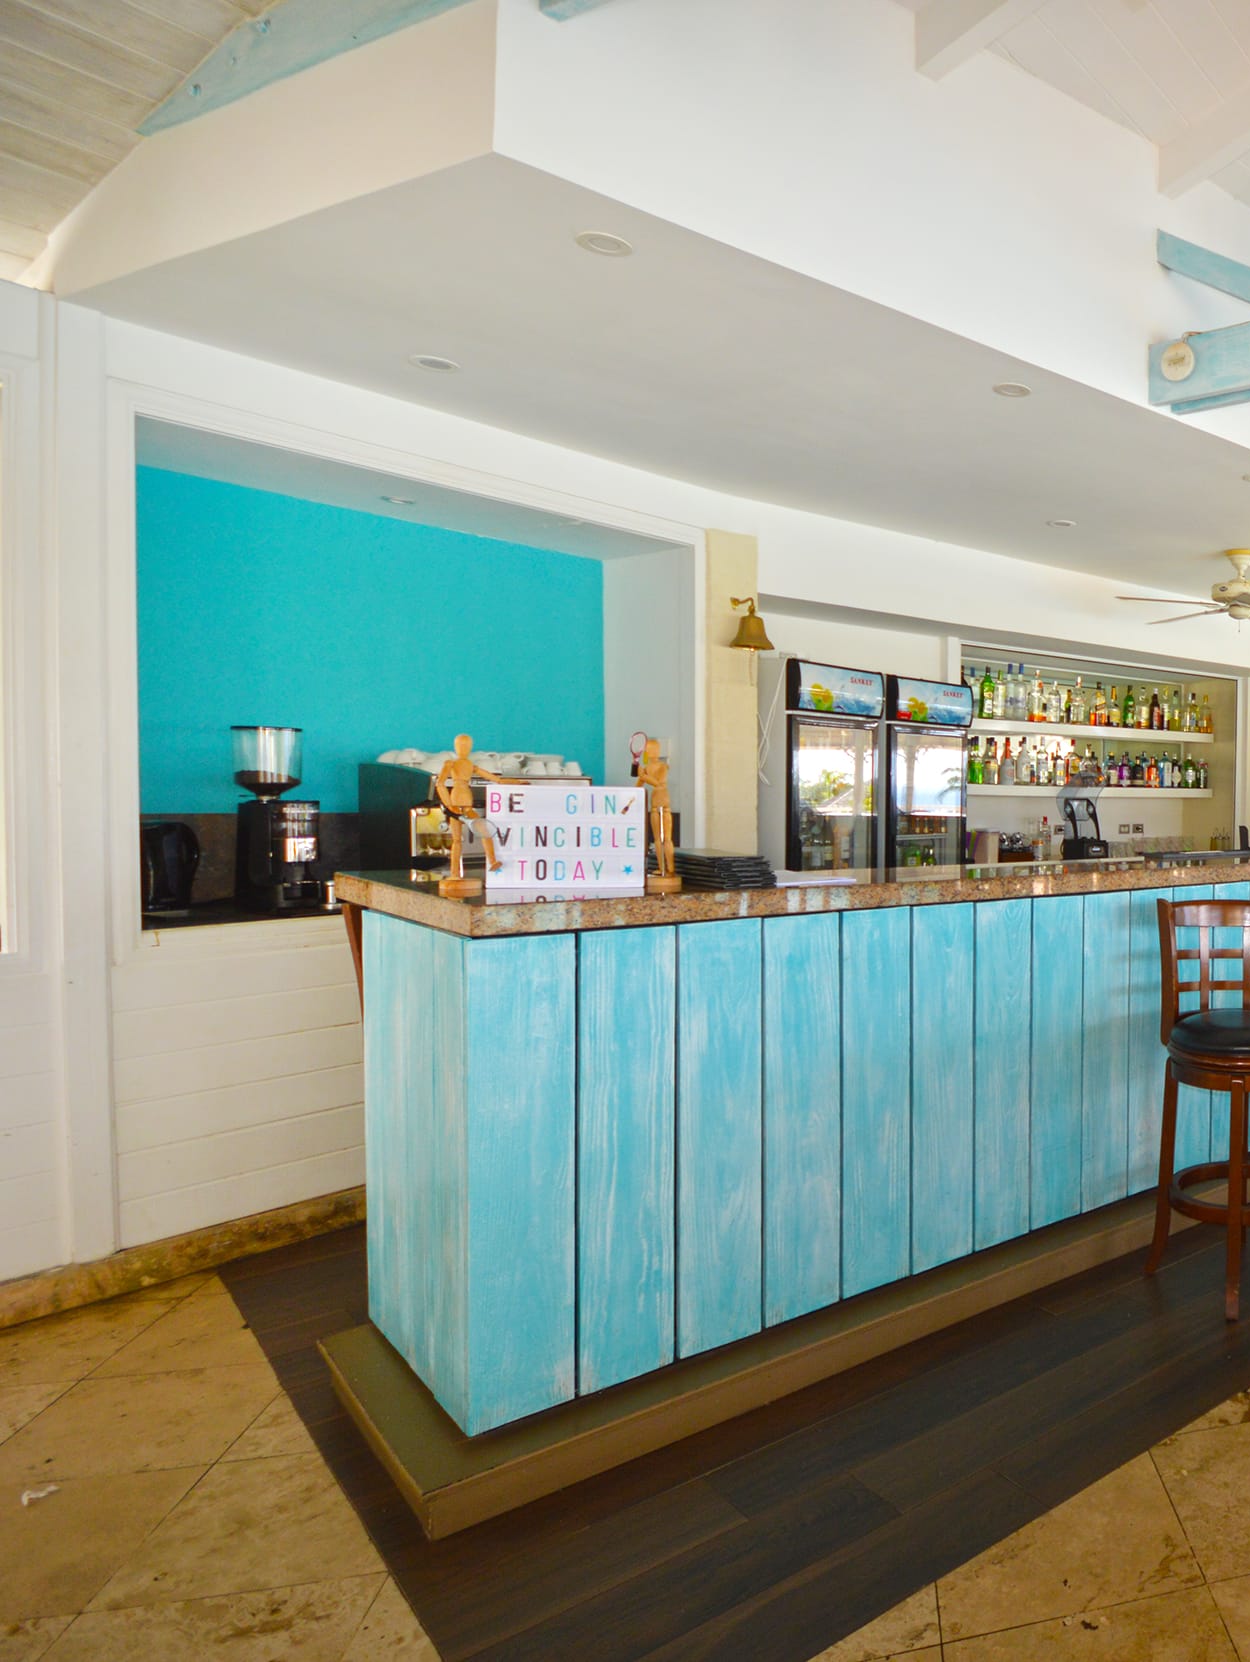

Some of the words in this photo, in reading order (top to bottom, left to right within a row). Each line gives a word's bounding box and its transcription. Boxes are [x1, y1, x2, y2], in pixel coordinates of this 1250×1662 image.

[490, 792, 524, 813] BE
[566, 793, 616, 815] GIN
[496, 825, 637, 848] VINCIBLE
[518, 859, 603, 881] TODAY
